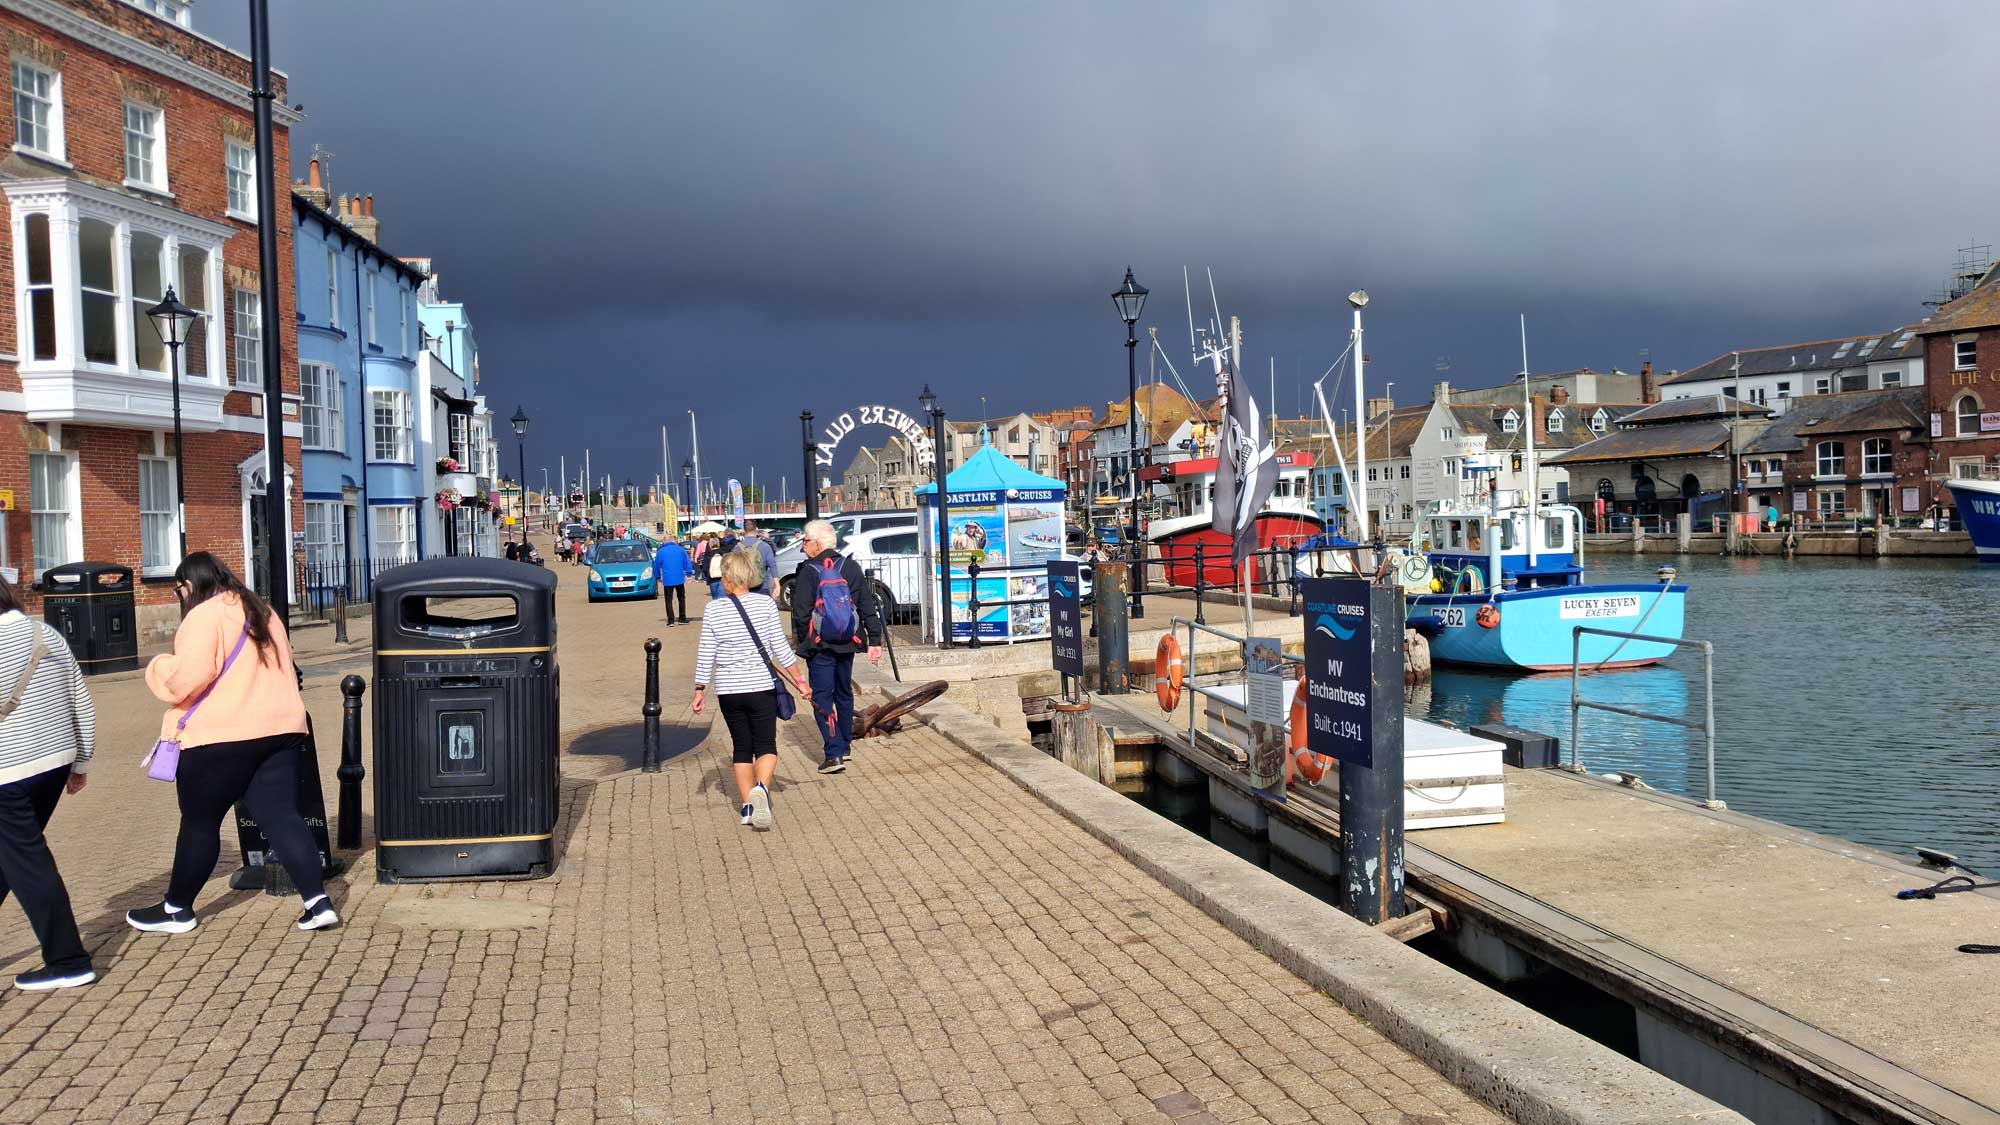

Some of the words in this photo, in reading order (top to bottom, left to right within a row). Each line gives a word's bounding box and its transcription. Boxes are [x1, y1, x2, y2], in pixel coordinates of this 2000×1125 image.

[947, 492, 997, 504] OASTLINE
[1019, 490, 1052, 500] CRUISES
[1367, 489, 1380, 499] HIP
[1307, 602, 1337, 615] COASTLINE
[1337, 604, 1365, 617] CRUISES
[1564, 599, 1600, 609] LUCKY
[1603, 597, 1637, 608] SEVEN
[1060, 610, 1068, 622] MV
[1585, 608, 1618, 617] EXETER
[1057, 625, 1065, 639] My
[1065, 626, 1074, 638] Girl
[1056, 645, 1066, 658] Built
[1066, 647, 1077, 660] 1931
[424, 660, 498, 673] LITTER
[1328, 658, 1343, 678] MV
[1309, 679, 1366, 707] Enchantress
[1314, 712, 1332, 735] Built
[1332, 719, 1363, 742] c.1941
